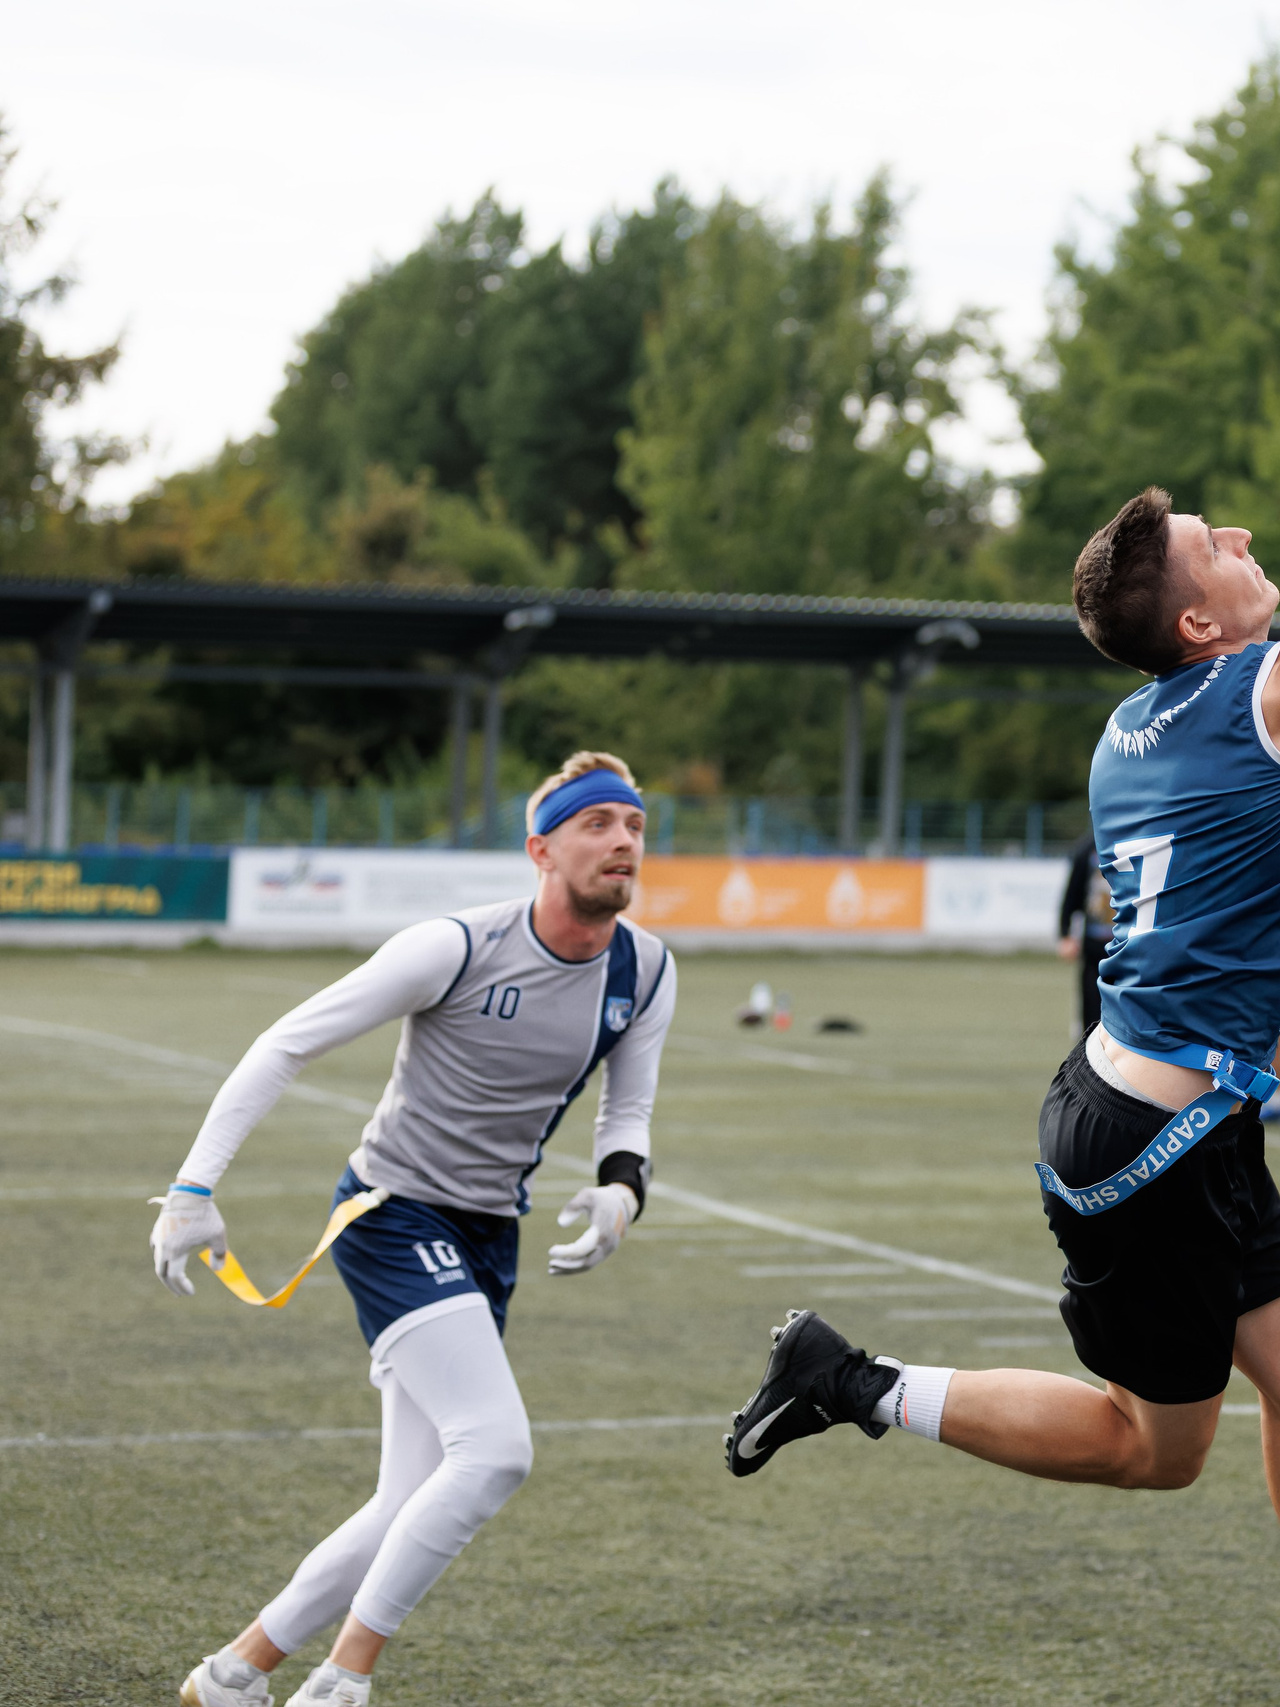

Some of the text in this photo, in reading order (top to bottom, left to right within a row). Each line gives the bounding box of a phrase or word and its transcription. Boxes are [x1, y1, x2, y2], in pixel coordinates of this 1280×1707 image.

[480, 984, 521, 1020] 10
[1118, 1106, 1211, 1187] CAPITAL
[412, 1240, 461, 1274] 10
[812, 1403, 832, 1424] ALPHA
